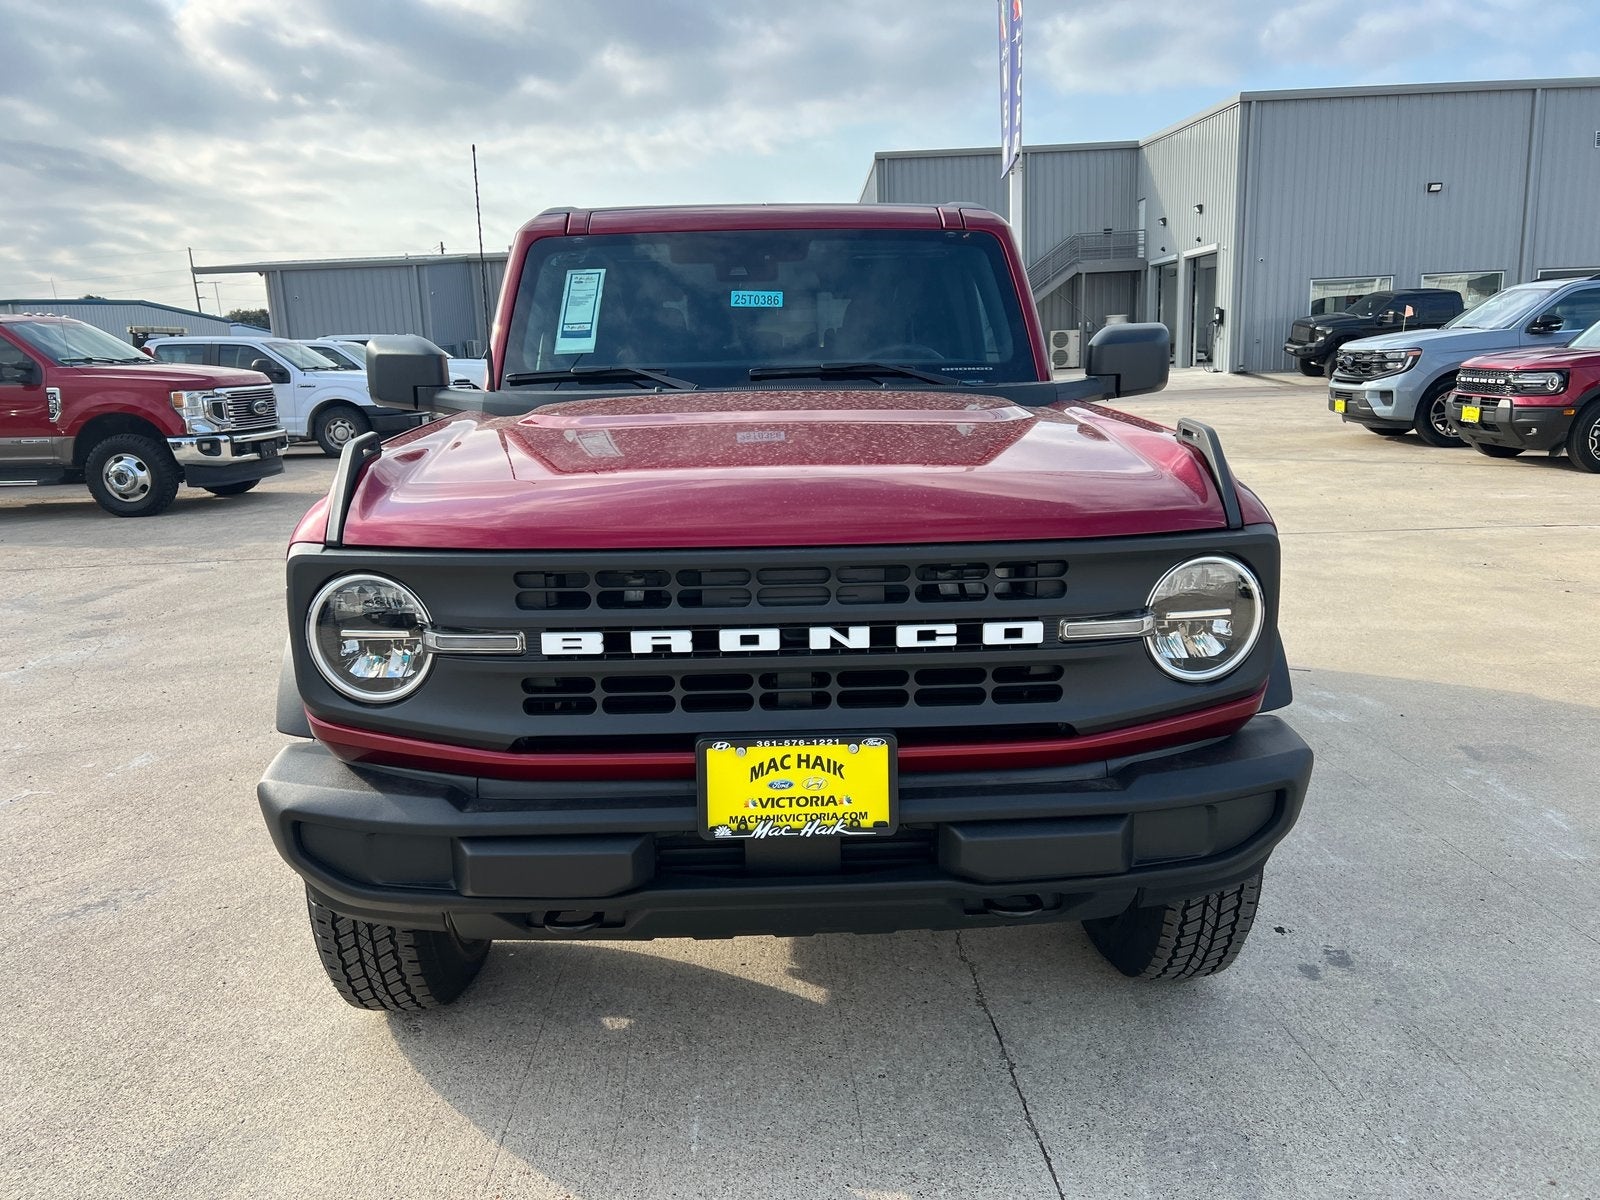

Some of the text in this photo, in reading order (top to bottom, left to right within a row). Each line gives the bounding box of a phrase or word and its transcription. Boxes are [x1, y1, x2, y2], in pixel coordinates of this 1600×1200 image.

[734, 294, 780, 305] 25T0386
[1460, 376, 1505, 384] BRONCO
[541, 621, 1044, 656] BRONCO
[756, 738, 840, 746] 361-576-1221
[750, 753, 845, 783] MAC HAIK
[770, 780, 792, 789] Ford
[758, 795, 839, 809] VICTORIA
[729, 812, 868, 824] MACHAIKVICTORIACOM
[751, 817, 853, 839] Mac Haik
